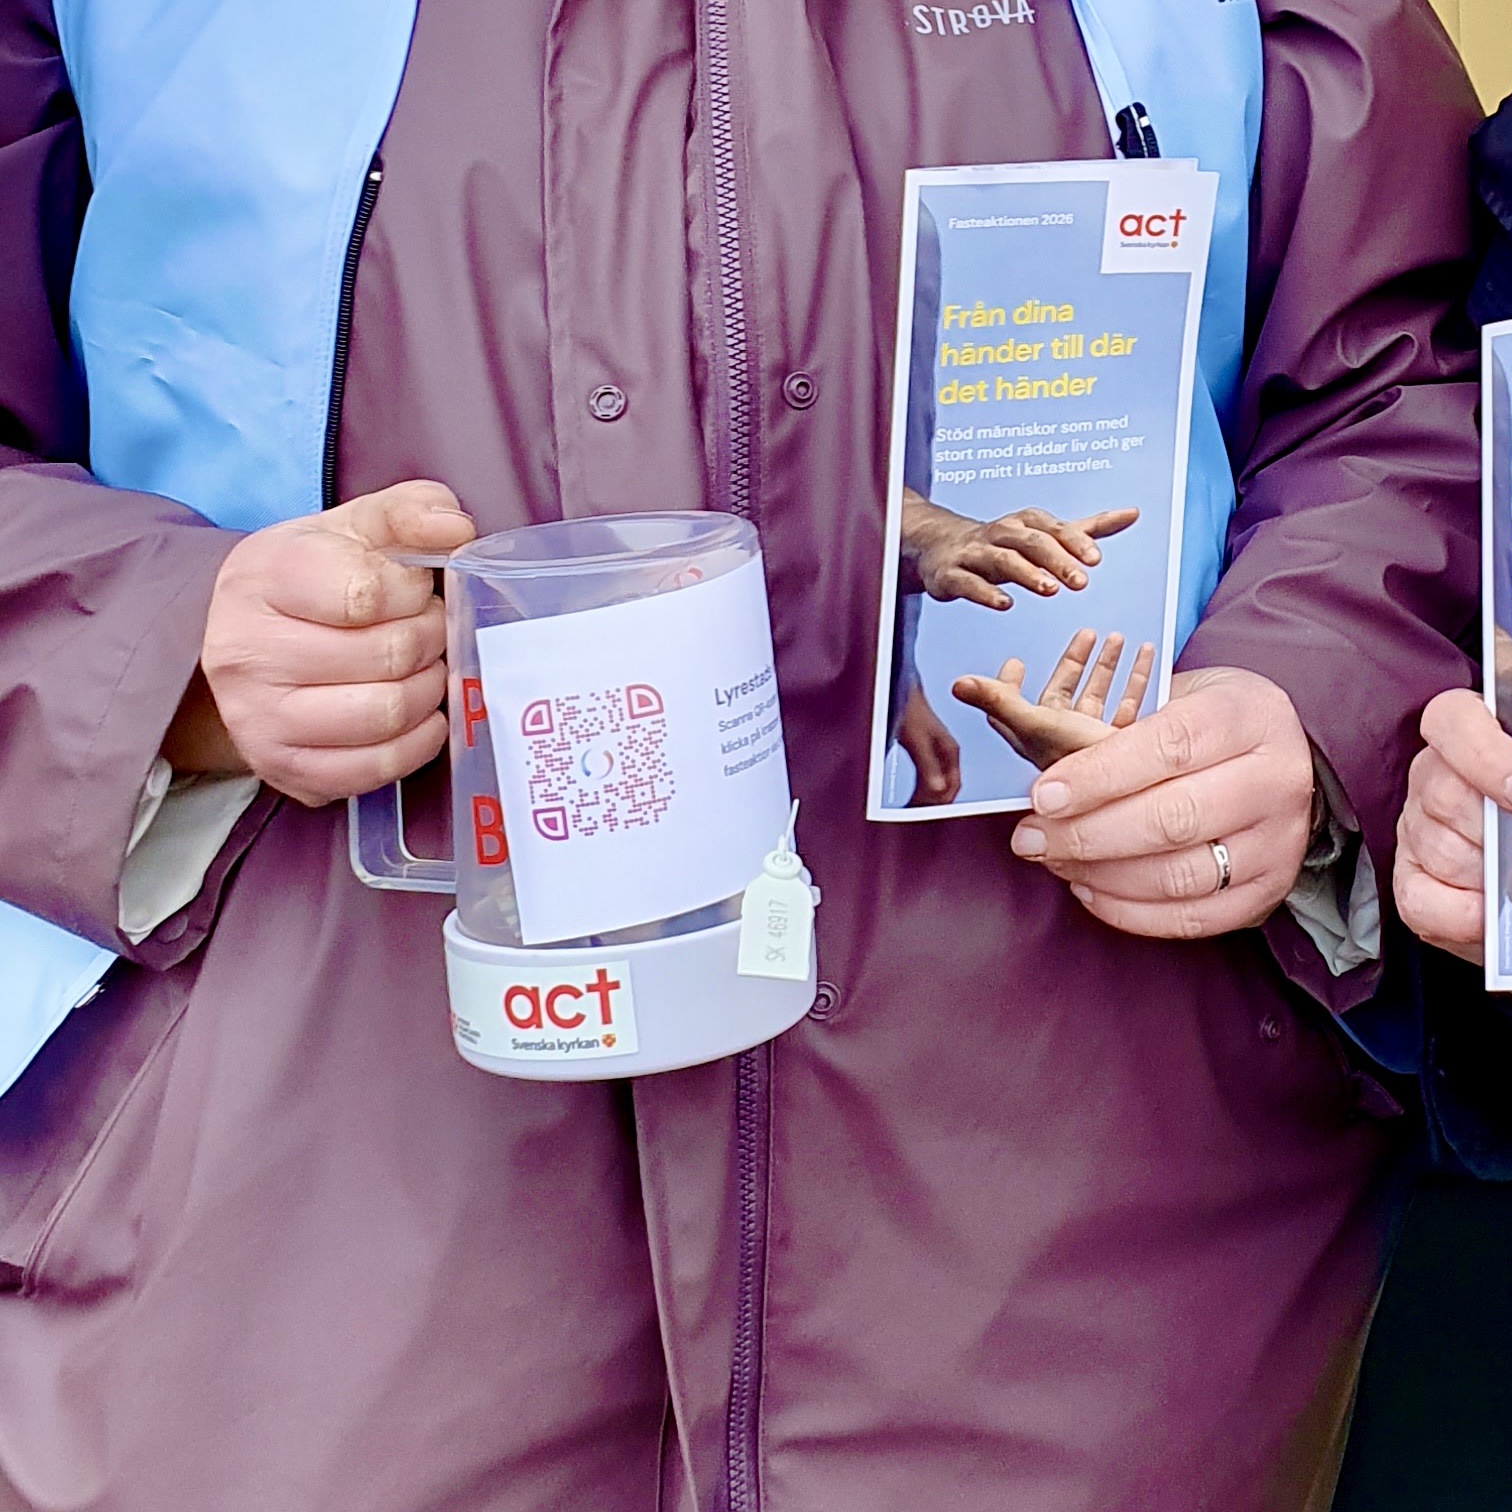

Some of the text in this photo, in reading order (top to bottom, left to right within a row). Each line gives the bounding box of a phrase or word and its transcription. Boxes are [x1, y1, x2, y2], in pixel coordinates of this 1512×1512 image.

[1041, 213, 1074, 226] 2026
[1119, 208, 1188, 237] act
[943, 299, 1075, 330] Från dina
[939, 332, 1138, 367] händer till där
[938, 372, 1098, 405] det händer
[935, 414, 1129, 443] Stöd människor som med
[935, 435, 1145, 463] stort mod räddar liv och ger
[934, 458, 1113, 485] hopp mitt i katastrofen.
[504, 968, 621, 1030] act
[511, 1038, 600, 1054] Svenska kyrkan
